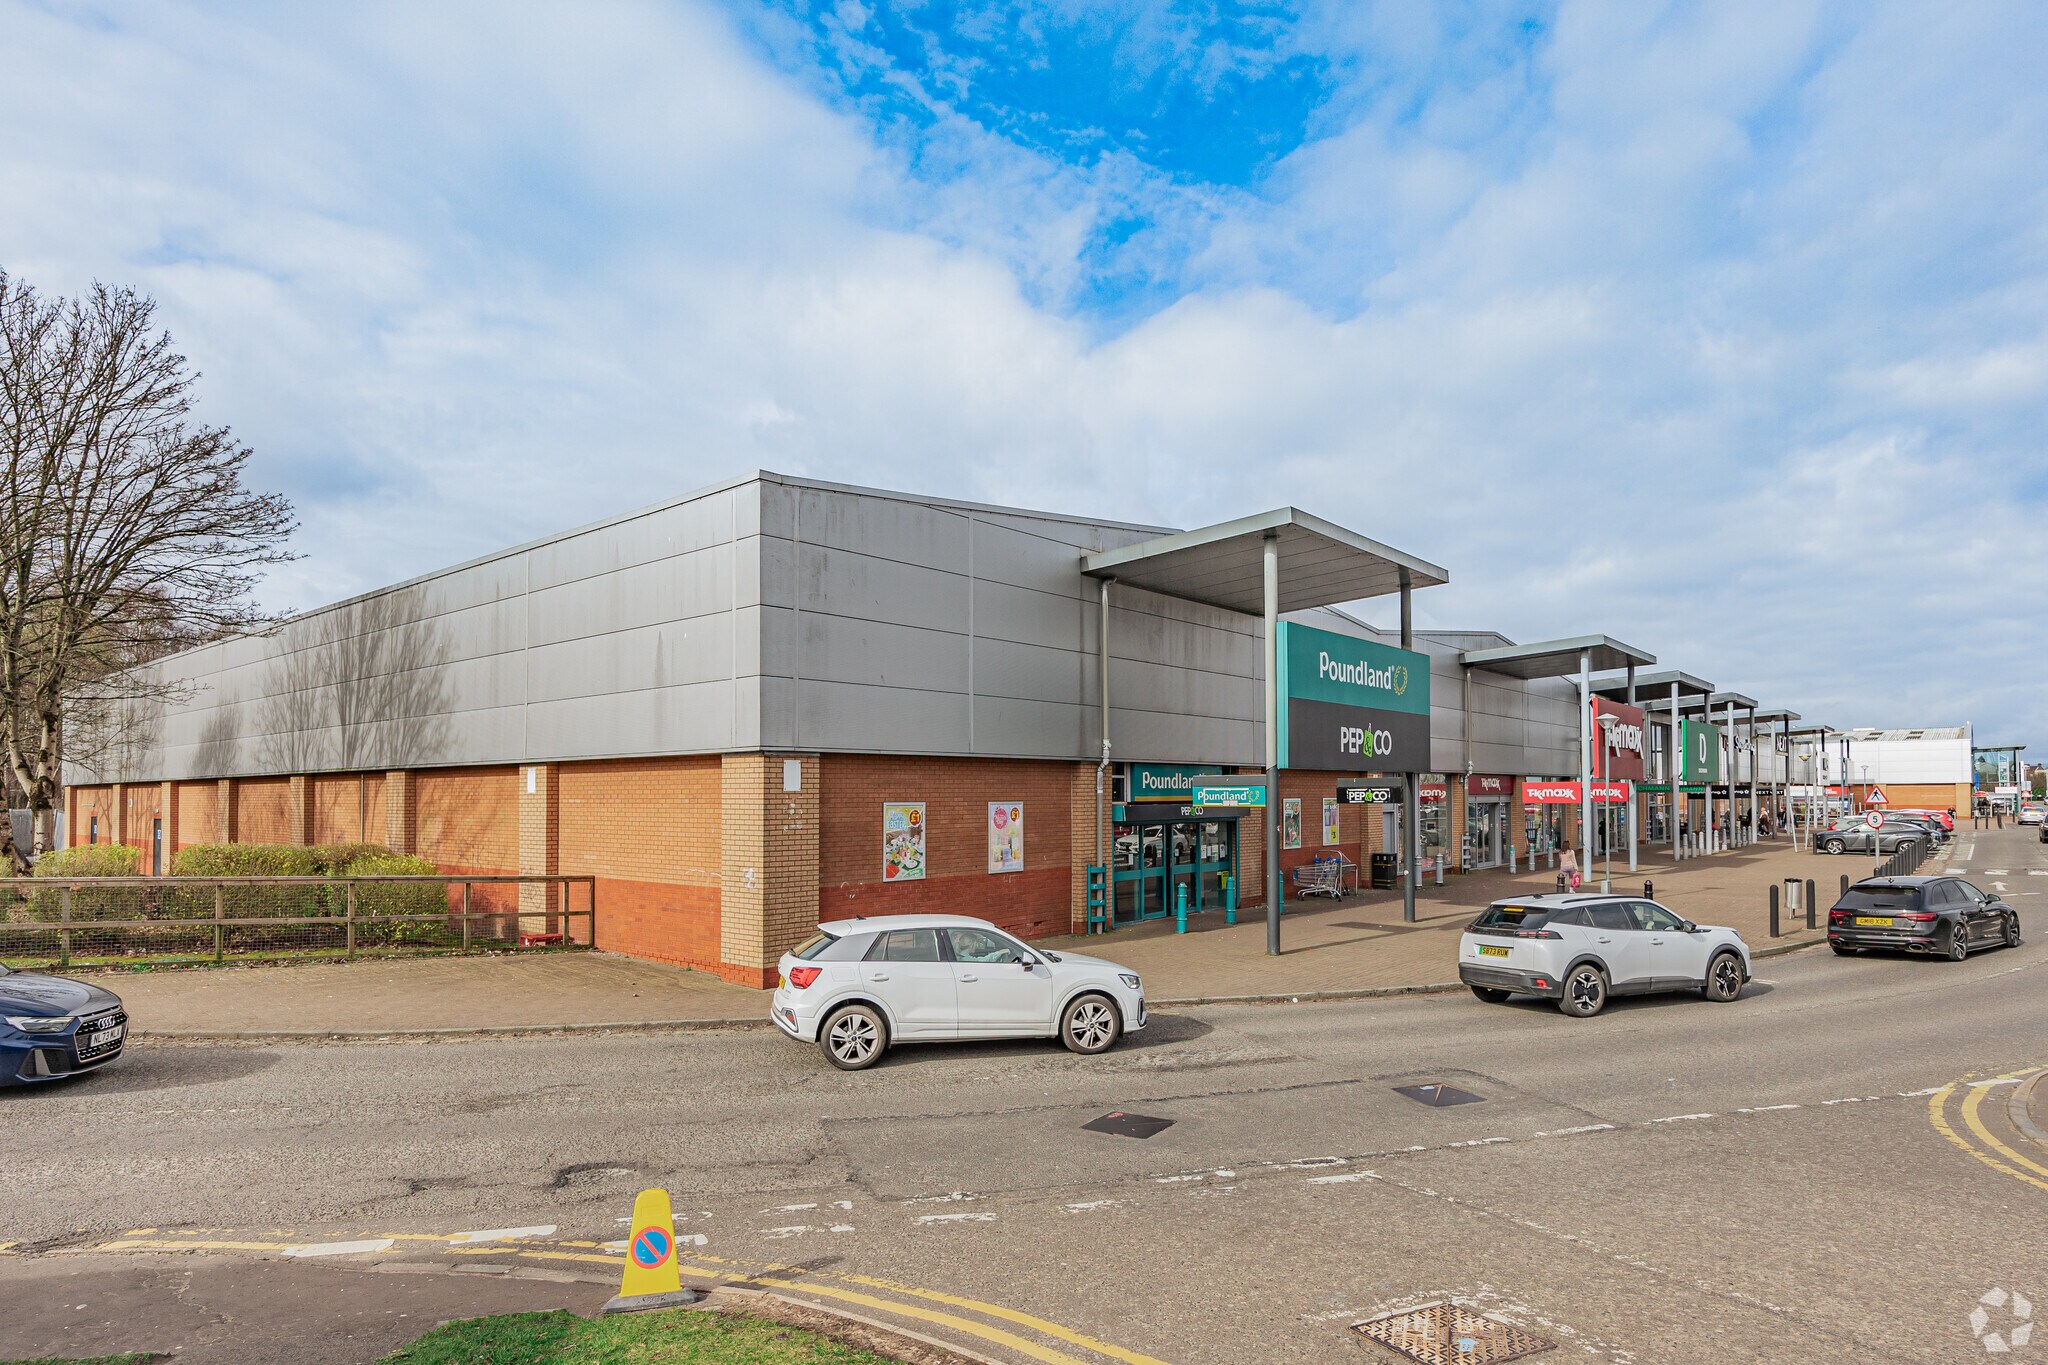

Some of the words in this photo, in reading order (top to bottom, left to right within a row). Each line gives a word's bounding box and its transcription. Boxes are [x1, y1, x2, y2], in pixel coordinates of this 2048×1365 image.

[1319, 651, 1392, 690] Poundland
[1142, 771, 1194, 789] Poundlan
[1197, 790, 1248, 801] Poundland
[1872, 815, 1878, 824] 5
